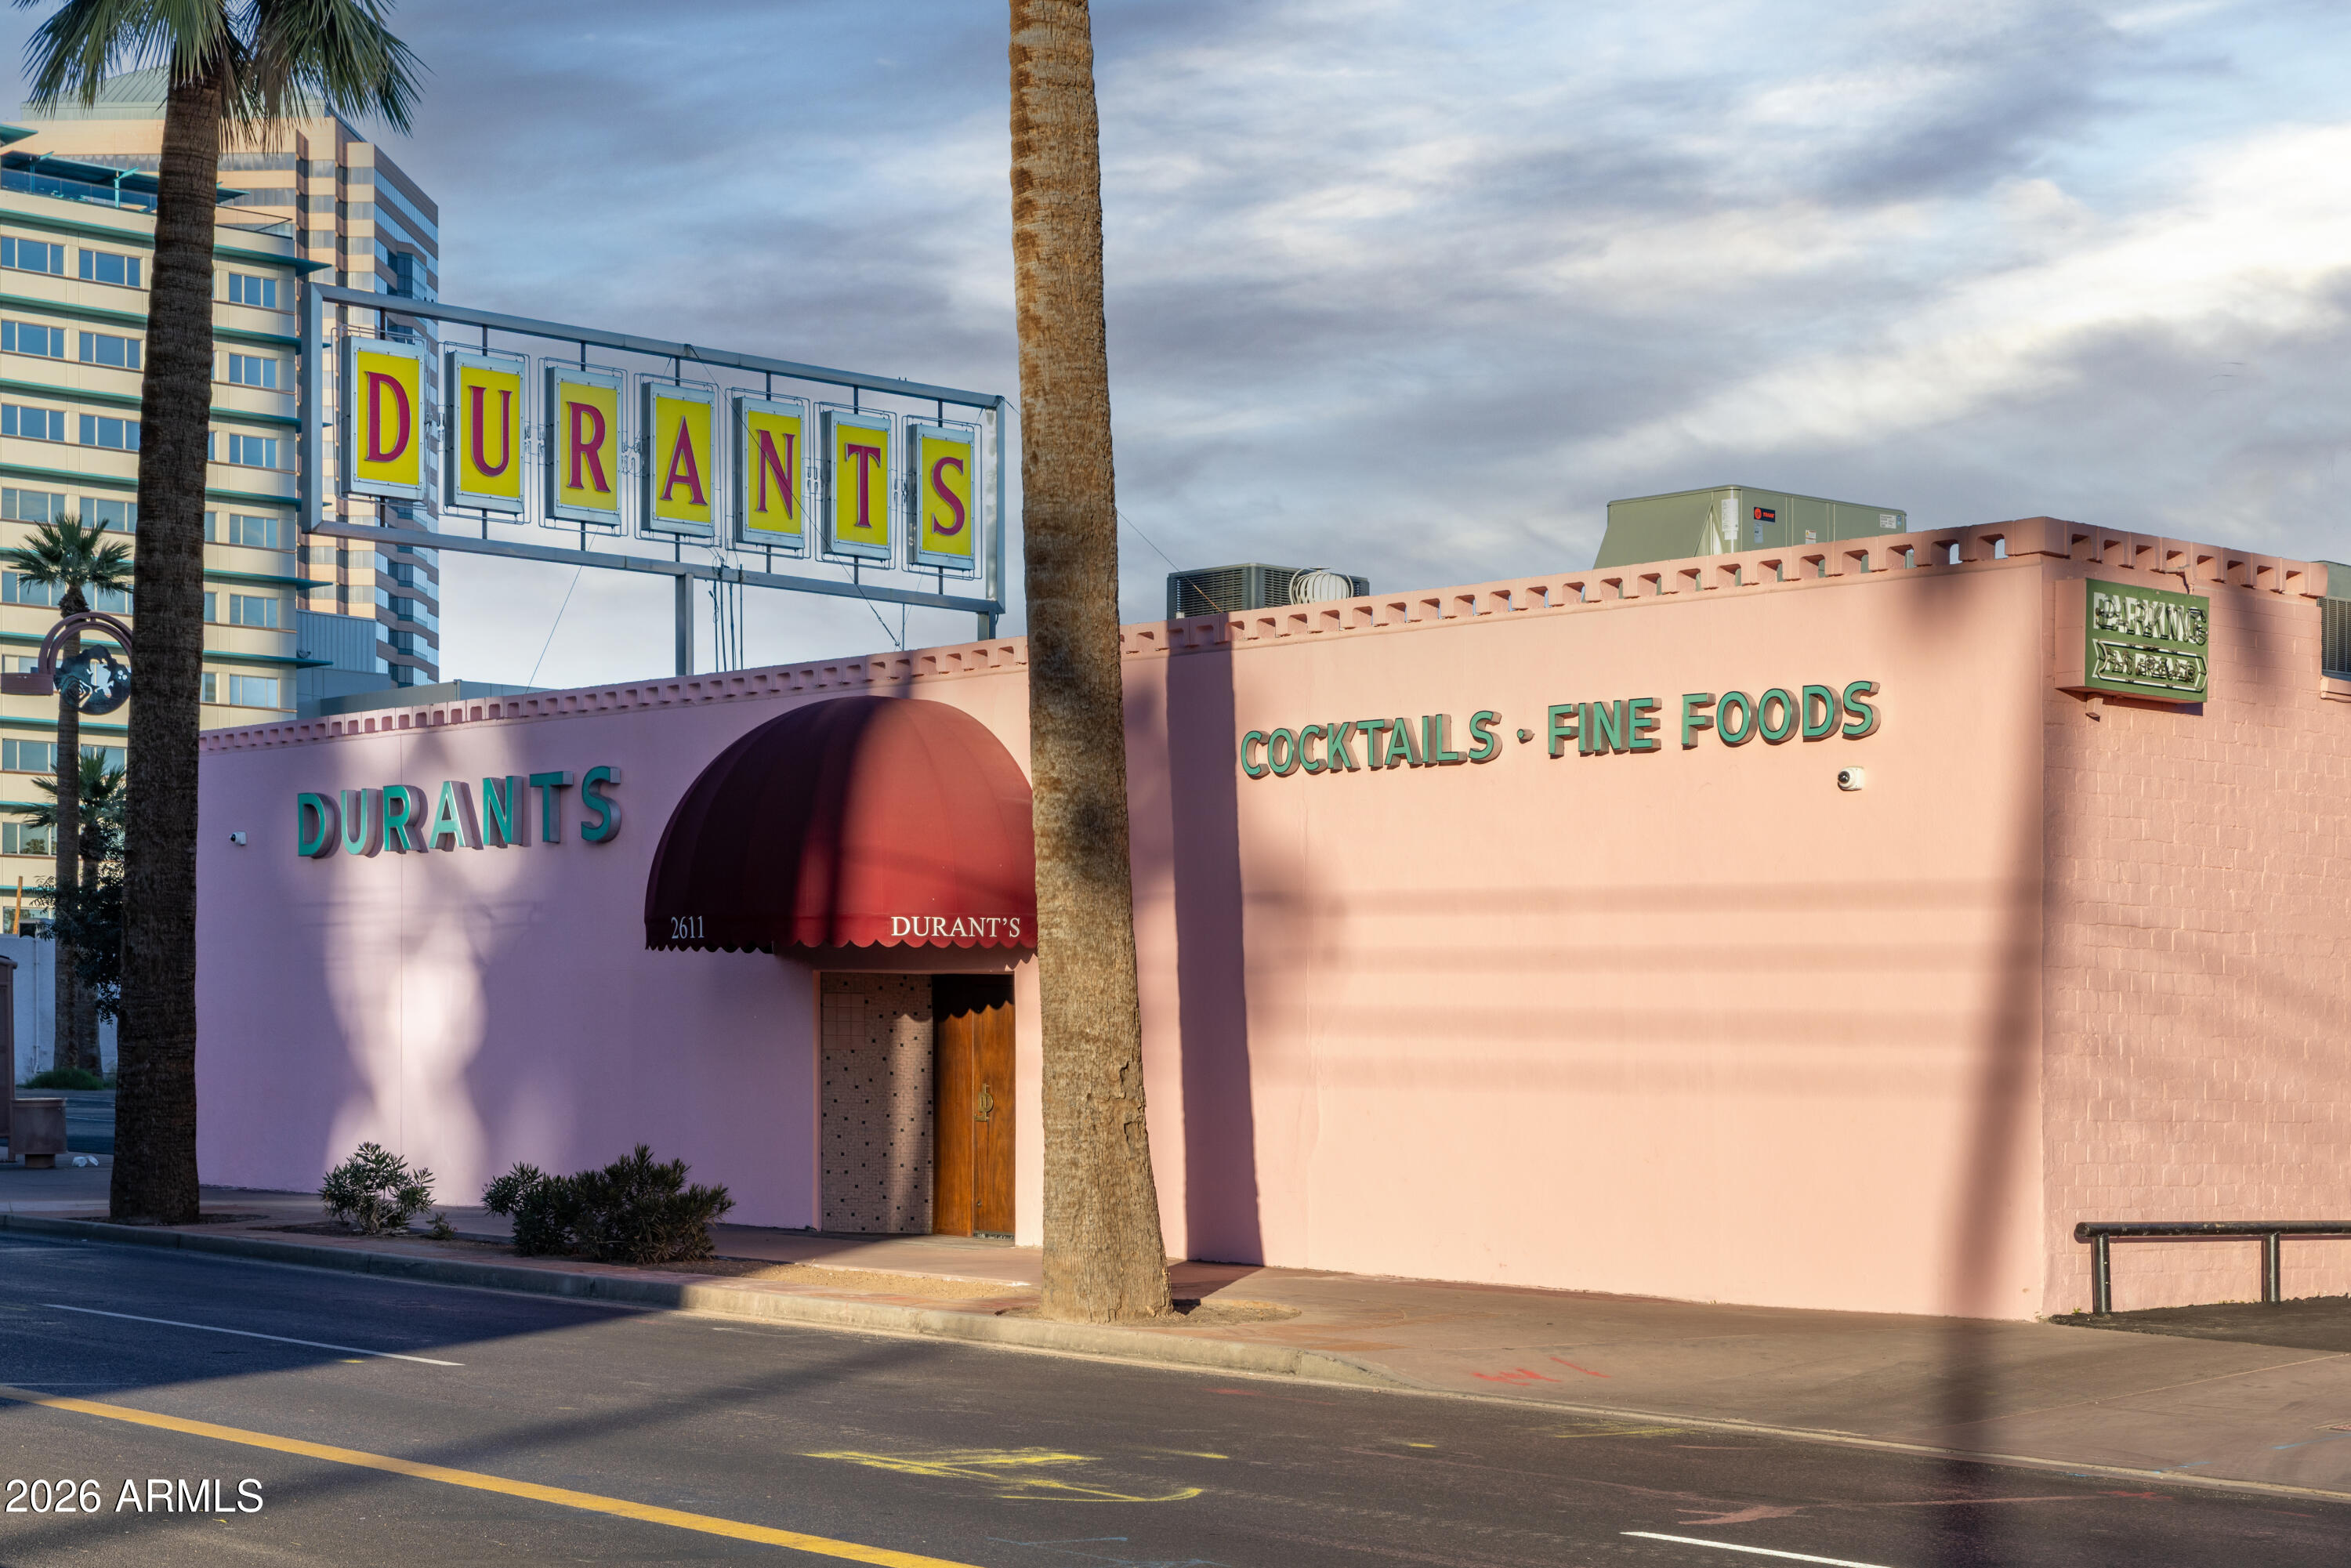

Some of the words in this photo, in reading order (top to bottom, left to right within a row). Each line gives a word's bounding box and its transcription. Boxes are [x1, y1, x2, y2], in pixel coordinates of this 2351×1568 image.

[364, 371, 965, 536] DURANTS
[2093, 592, 2208, 646] PARKING
[1241, 710, 1503, 780] COCKTAILS
[1548, 697, 1662, 759] FINE
[1681, 680, 1881, 750] FOODS
[297, 765, 621, 859] DURANTS
[670, 915, 705, 940] 2611
[890, 915, 1021, 938] DURANT'S
